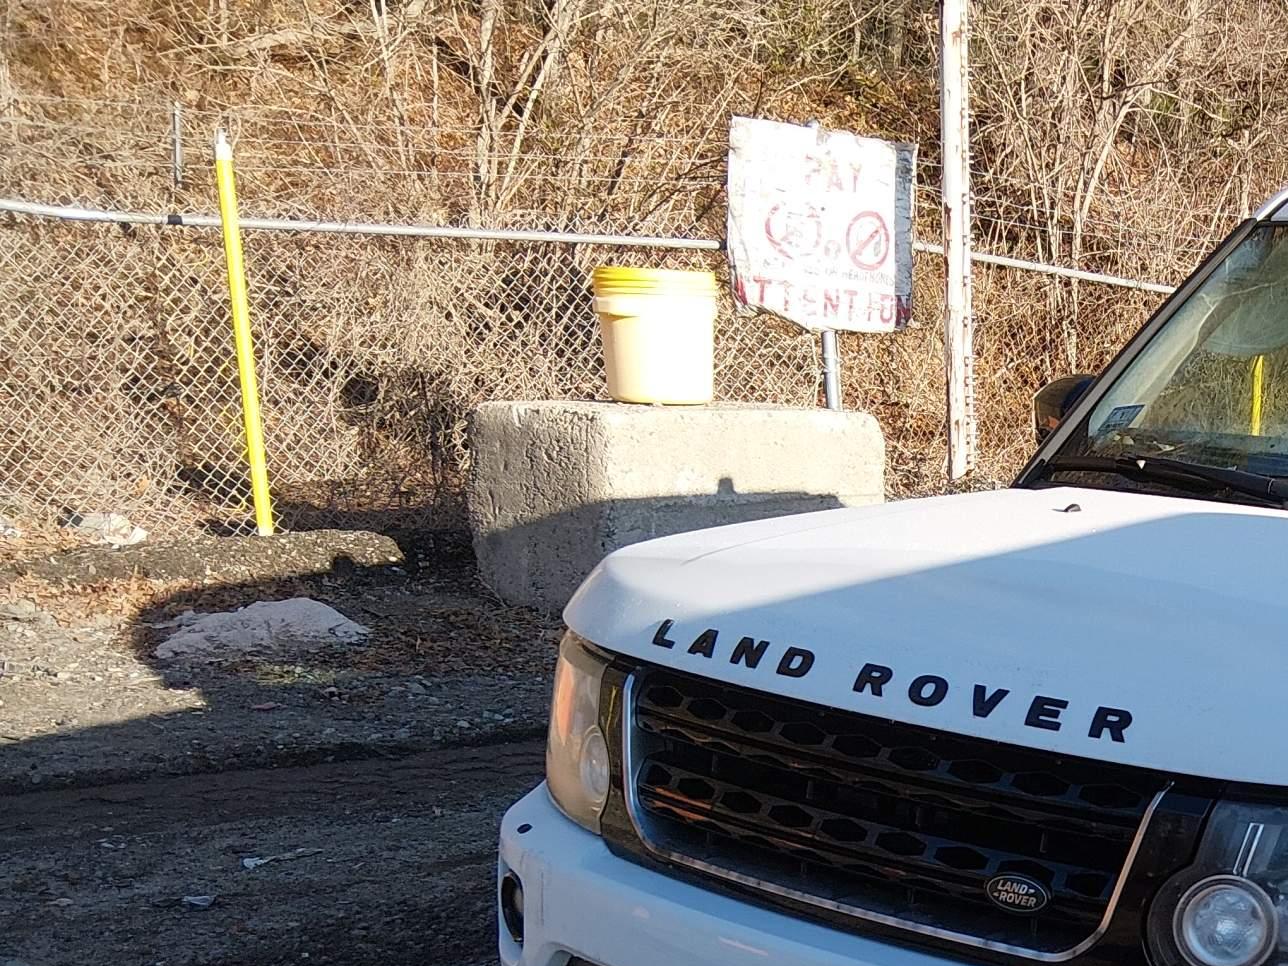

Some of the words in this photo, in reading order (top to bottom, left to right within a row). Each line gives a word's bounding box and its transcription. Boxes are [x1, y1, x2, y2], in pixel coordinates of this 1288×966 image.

[804, 153, 863, 194] PAY
[651, 618, 816, 679] LAND
[852, 662, 1134, 744] ROVER
[997, 880, 1028, 894] LAND
[999, 891, 1037, 908] ROVER
